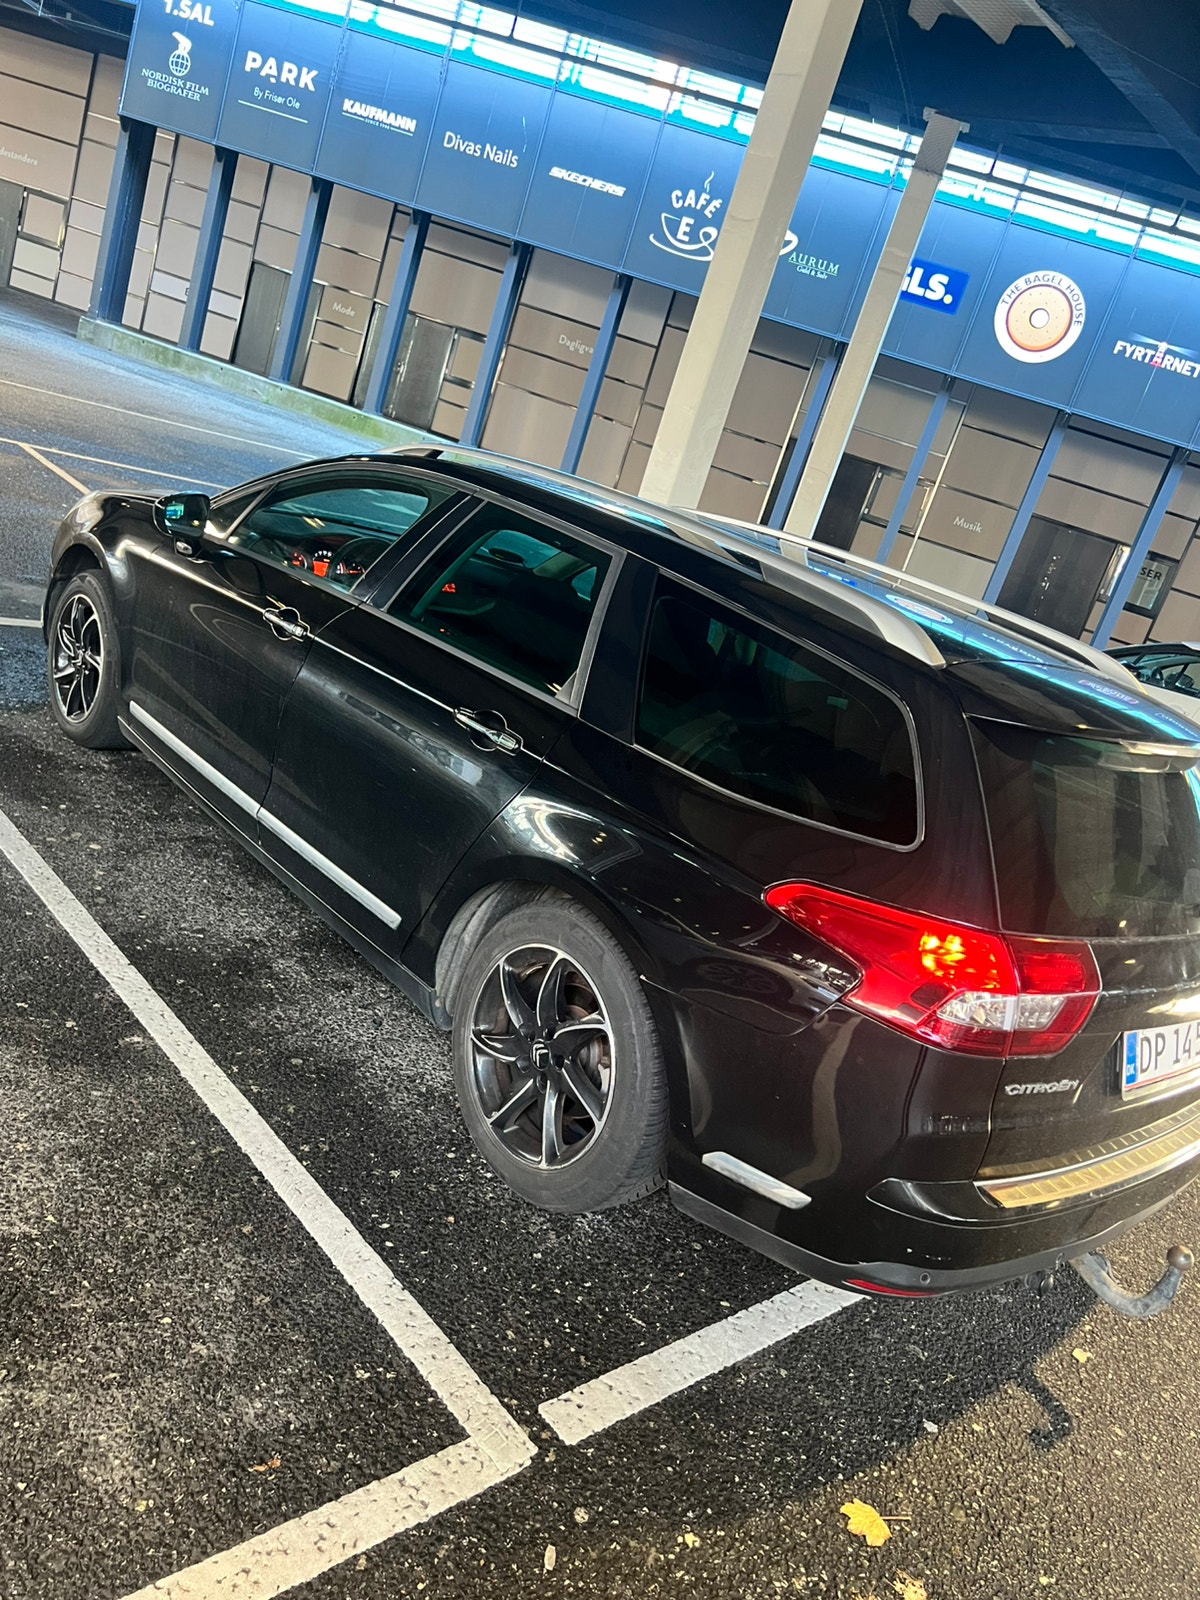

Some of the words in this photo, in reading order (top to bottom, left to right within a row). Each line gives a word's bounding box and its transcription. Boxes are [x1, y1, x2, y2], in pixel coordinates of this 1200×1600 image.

[141, 68, 185, 88] NORDISK
[185, 81, 209, 96] FILM
[244, 50, 319, 92] PARK
[147, 78, 201, 102] BIOGRAFER
[253, 86, 264, 100] By
[286, 96, 301, 109] Ole
[342, 98, 417, 133] KAUFMANN
[442, 131, 481, 157] Divas
[483, 143, 519, 168] Nails
[548, 166, 627, 197] SKECHERS
[671, 188, 724, 219] CAFÉ
[788, 251, 840, 275] AURUM
[332, 301, 356, 317] Mode
[1000, 283, 1022, 305] THE
[1024, 273, 1064, 288] BAGEL
[1060, 284, 1084, 327] HOUSE
[953, 515, 983, 533] Musik
[1140, 1031, 1166, 1074] DP
[1126, 1063, 1136, 1076] DK
